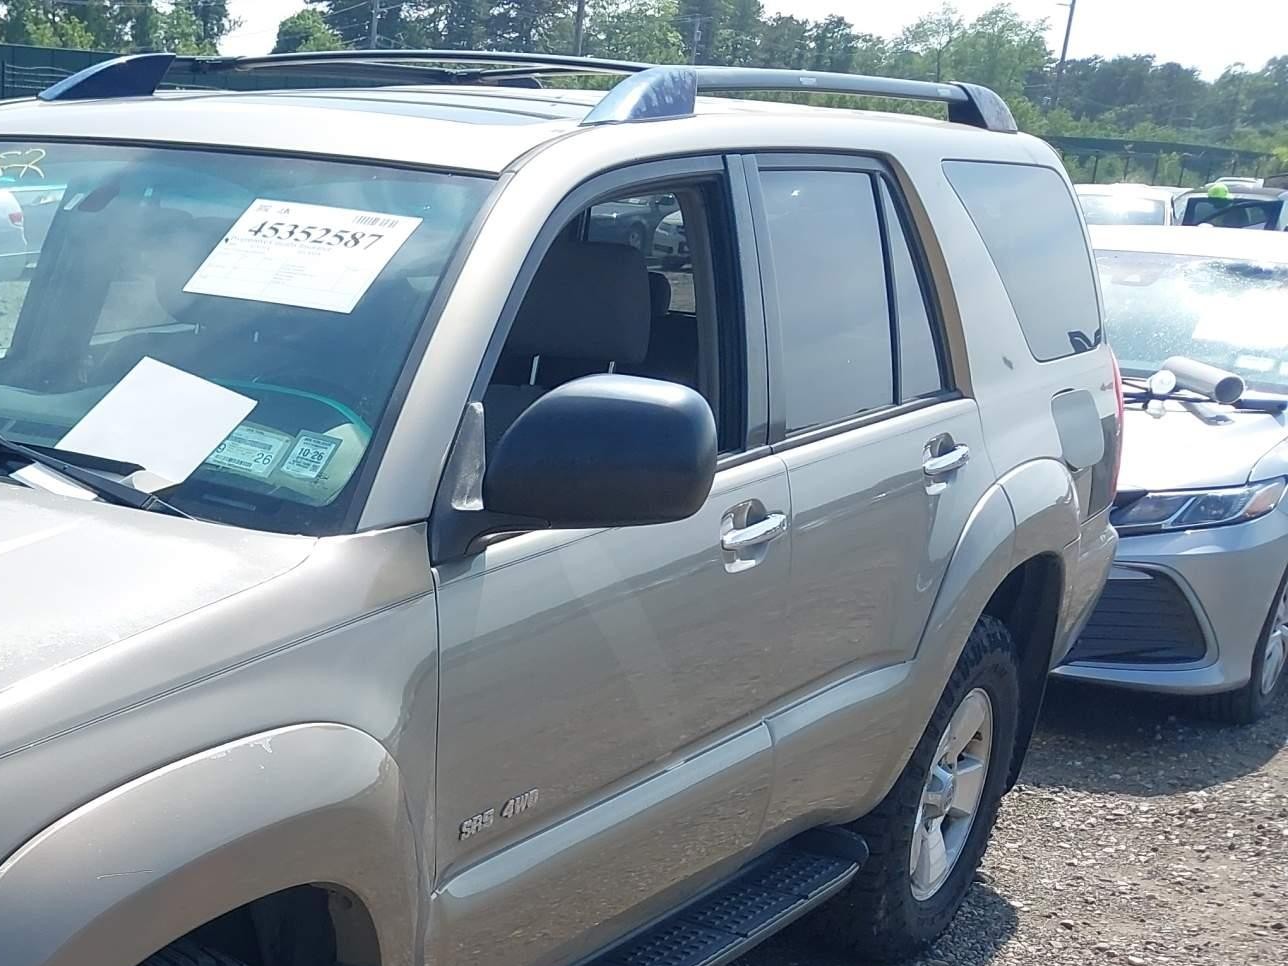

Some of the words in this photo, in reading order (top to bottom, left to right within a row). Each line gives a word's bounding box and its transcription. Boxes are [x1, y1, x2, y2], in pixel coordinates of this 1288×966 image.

[247, 219, 385, 251] 45352587
[253, 452, 273, 466] 26
[458, 807, 495, 841] SR5
[500, 786, 540, 819] 4WD
